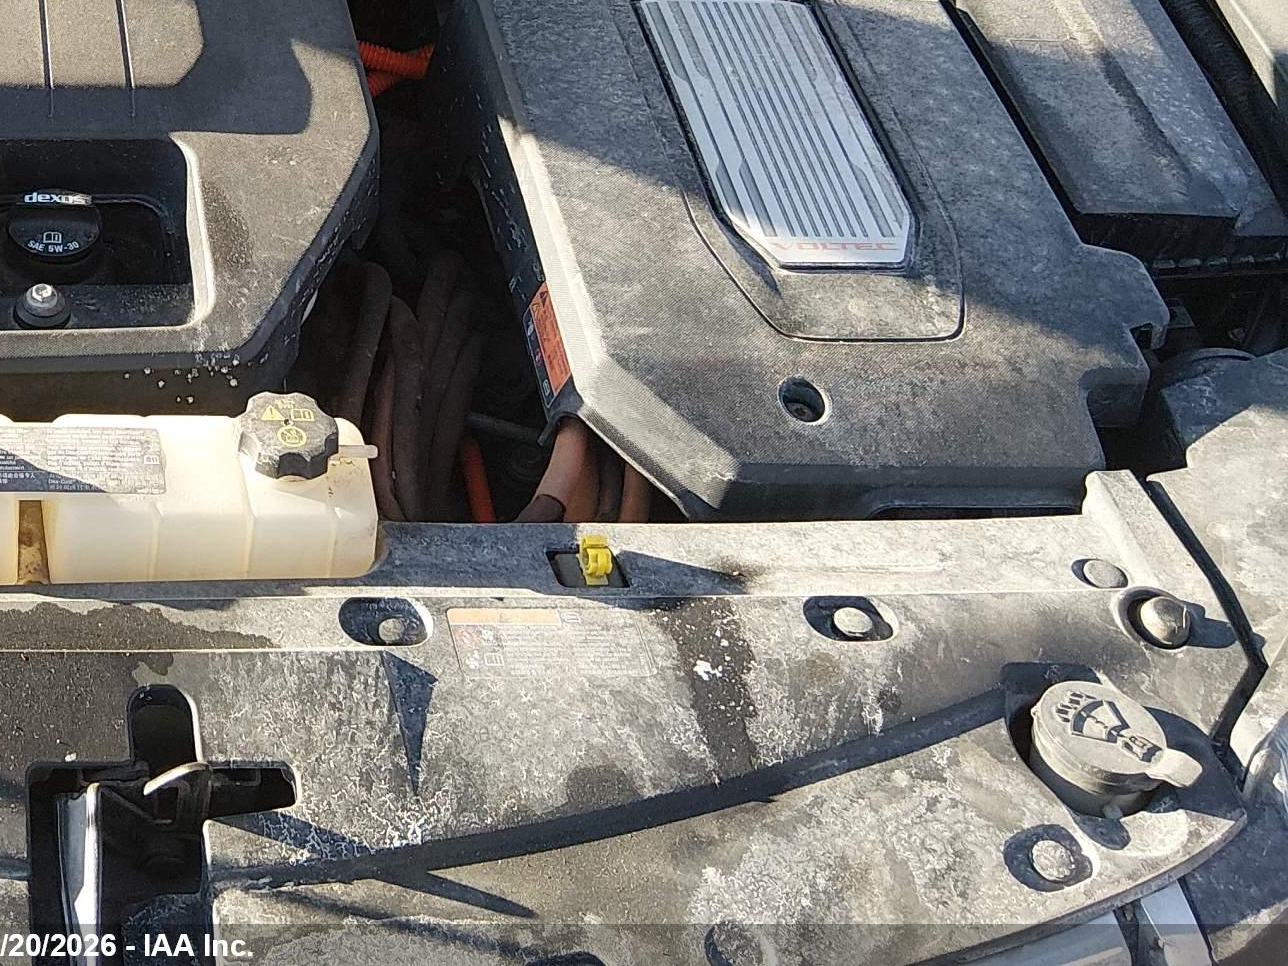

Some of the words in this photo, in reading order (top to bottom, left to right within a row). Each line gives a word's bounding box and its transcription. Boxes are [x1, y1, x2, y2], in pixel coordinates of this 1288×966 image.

[27, 240, 45, 252] SAE
[48, 241, 80, 253] 5W-30
[773, 241, 899, 251] VOLTEC
